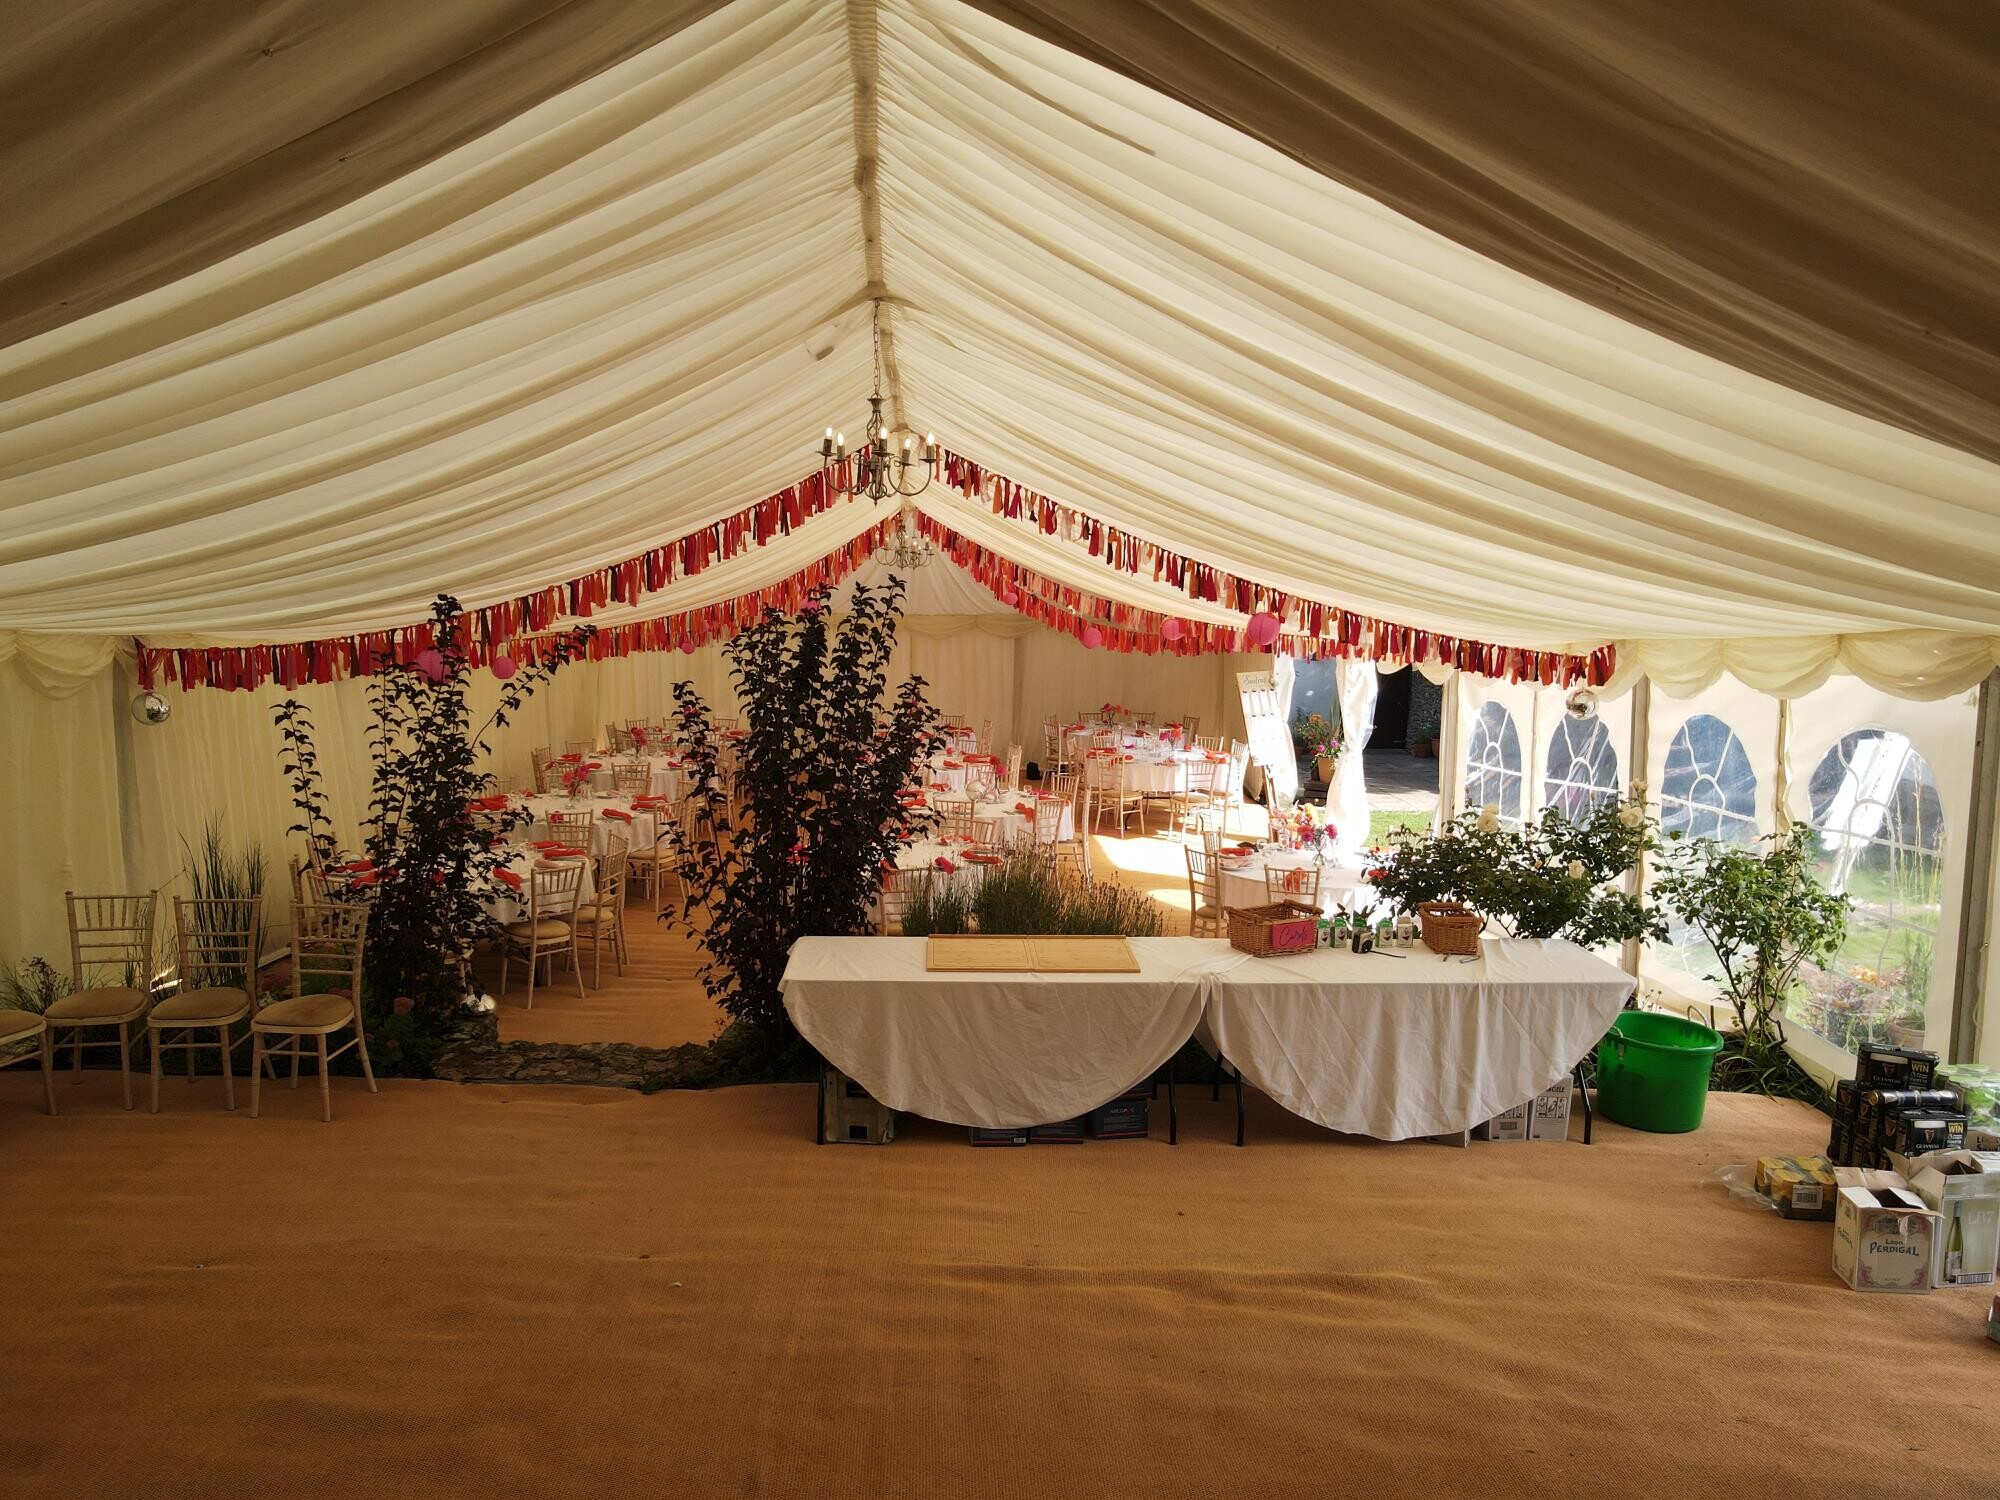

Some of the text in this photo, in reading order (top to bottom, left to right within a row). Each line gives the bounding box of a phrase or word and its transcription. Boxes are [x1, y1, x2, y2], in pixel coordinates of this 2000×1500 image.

[1911, 1062, 1930, 1074] WIN
[1872, 1074, 1902, 1084] GUINNESS
[1948, 1125, 1964, 1134] WIN
[1869, 1241, 1920, 1257] PERDIGAL
